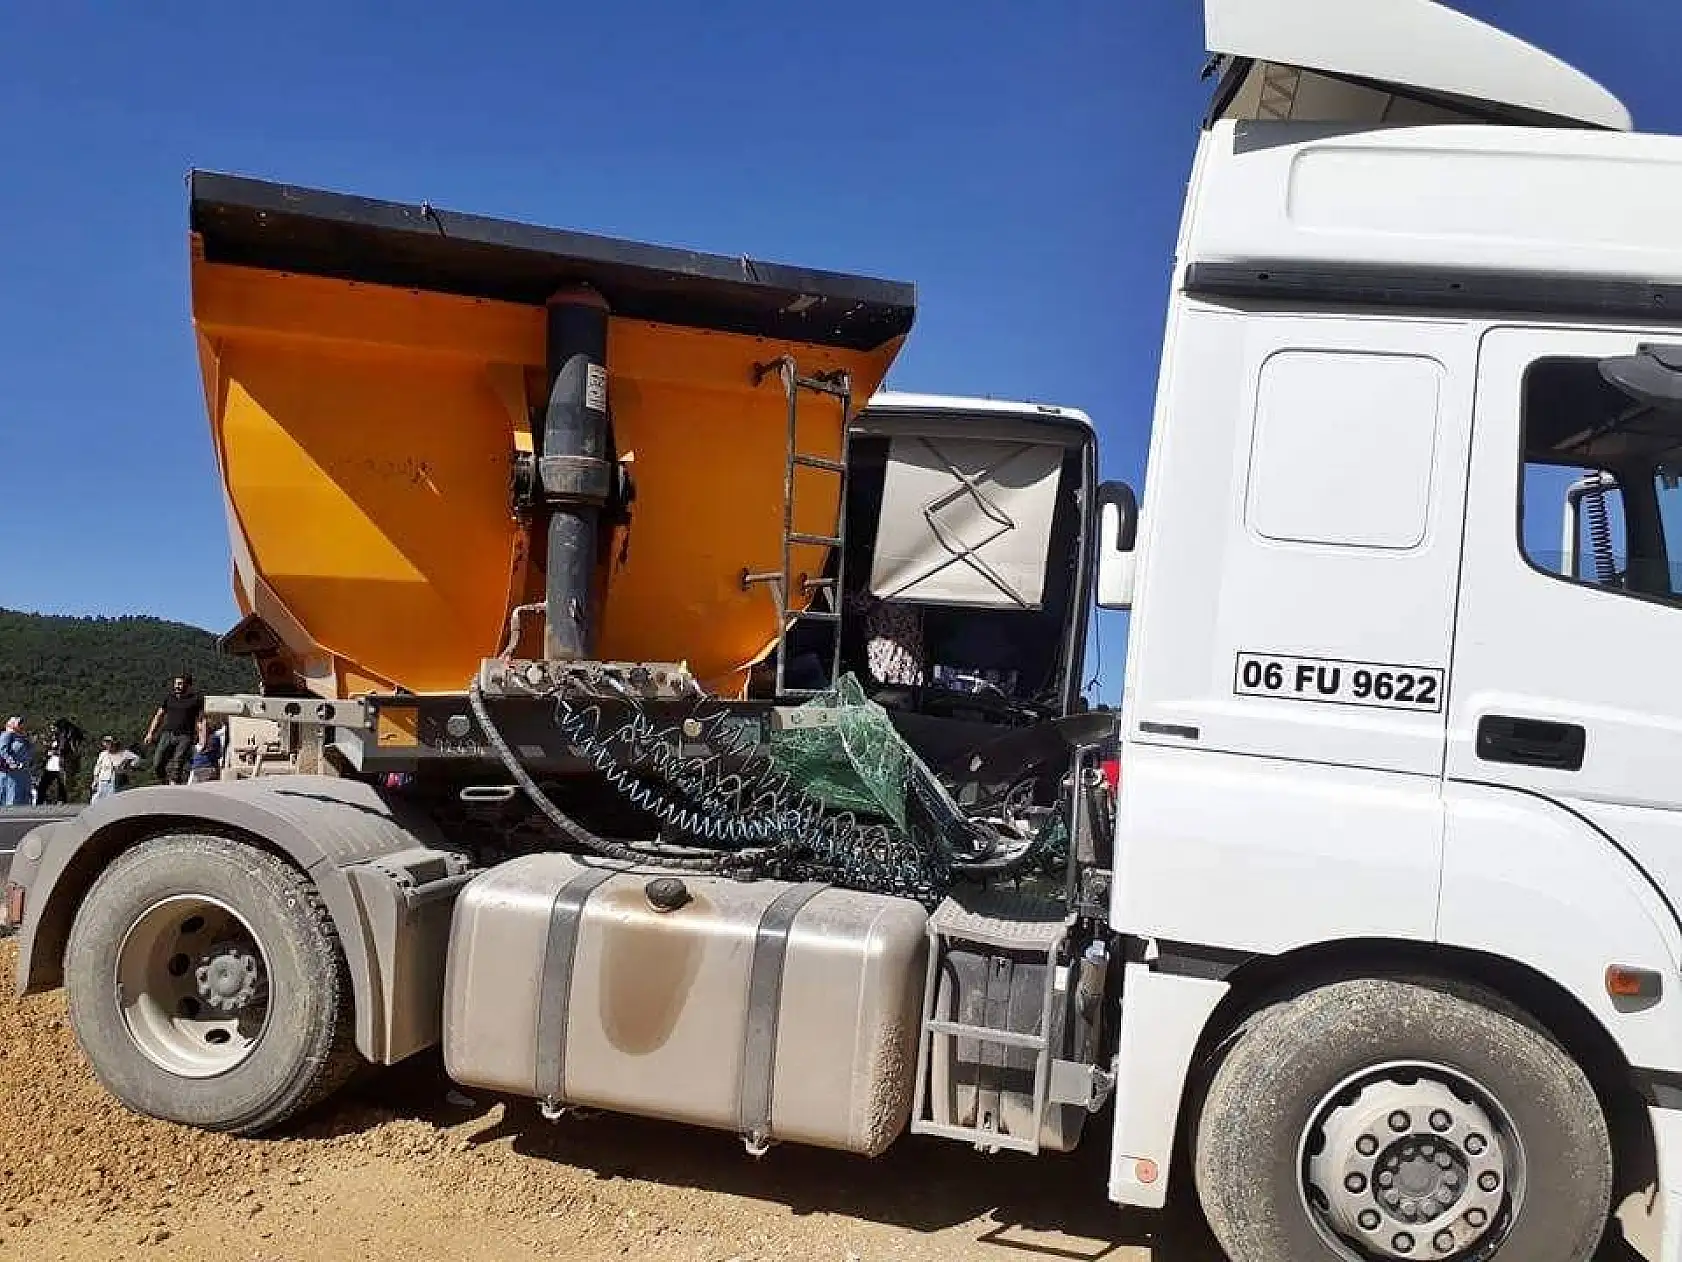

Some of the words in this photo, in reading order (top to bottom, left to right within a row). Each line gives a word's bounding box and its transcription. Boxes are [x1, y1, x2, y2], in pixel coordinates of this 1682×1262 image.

[1243, 660, 1282, 689] 06
[1295, 665, 1340, 694] FU
[1352, 669, 1437, 703] 9622
